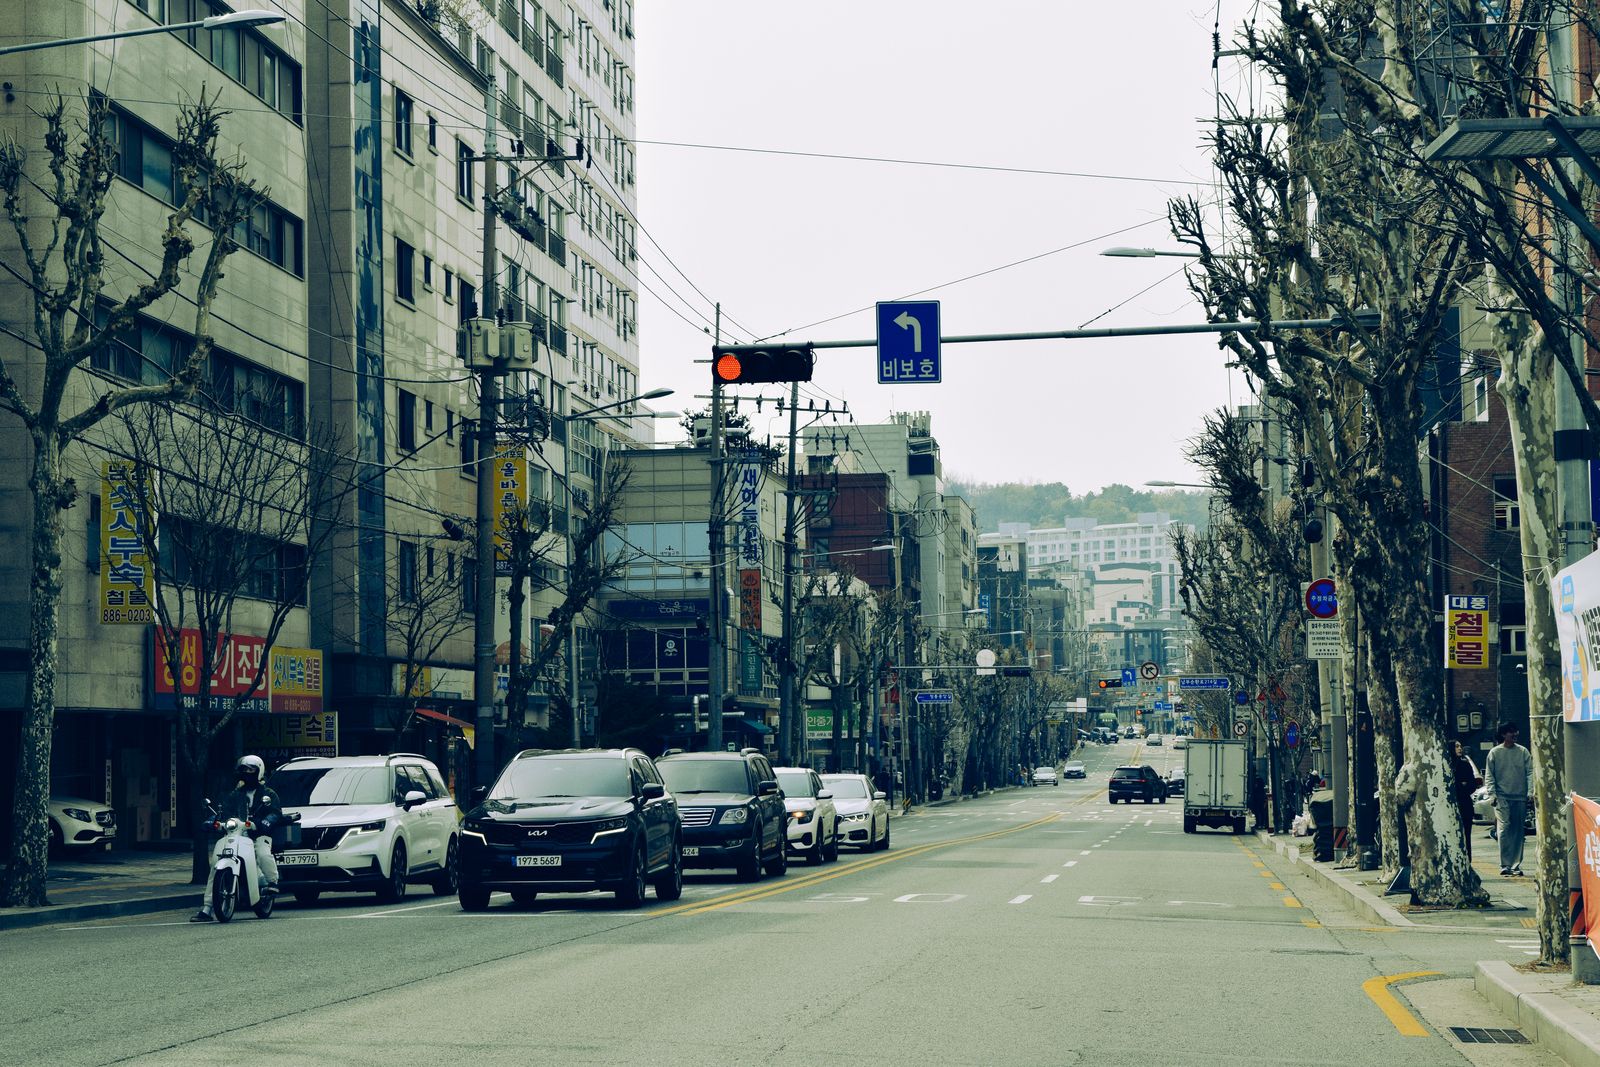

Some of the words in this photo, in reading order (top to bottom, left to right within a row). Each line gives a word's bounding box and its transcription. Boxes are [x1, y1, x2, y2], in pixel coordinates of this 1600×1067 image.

[883, 358, 936, 380] 비보호
[103, 609, 150, 622] 886-0203
[1454, 613, 1483, 665] 철물
[540, 857, 560, 865] 5687
